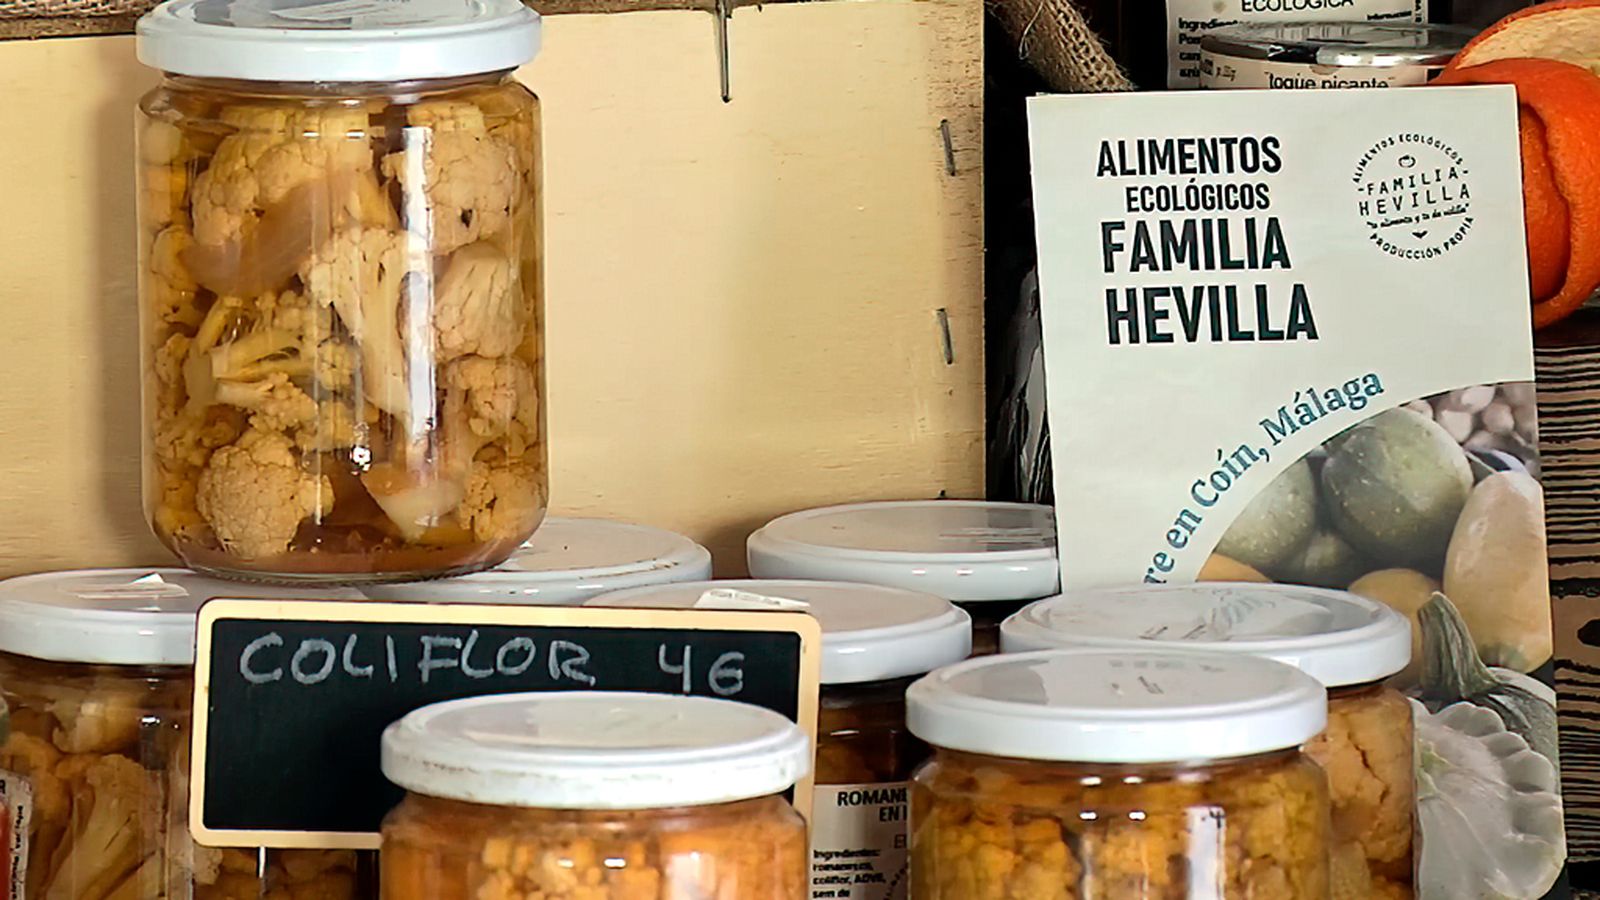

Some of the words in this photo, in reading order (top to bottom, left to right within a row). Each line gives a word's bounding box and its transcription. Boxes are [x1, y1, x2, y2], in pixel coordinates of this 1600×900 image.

[1097, 136, 1281, 177] ALIMENTOS
[1352, 137, 1395, 183] ALIMENTOS
[1126, 178, 1270, 212] ECOLÓGICOS
[1359, 183, 1470, 216] HEVILLA
[1101, 217, 1292, 273] FAMILIA
[1443, 217, 1474, 250] PROPIA
[1106, 284, 1319, 344] HEVILLA
[1166, 508, 1203, 549] en
[1190, 443, 1271, 507] Coín,
[1259, 372, 1385, 446] Málaga
